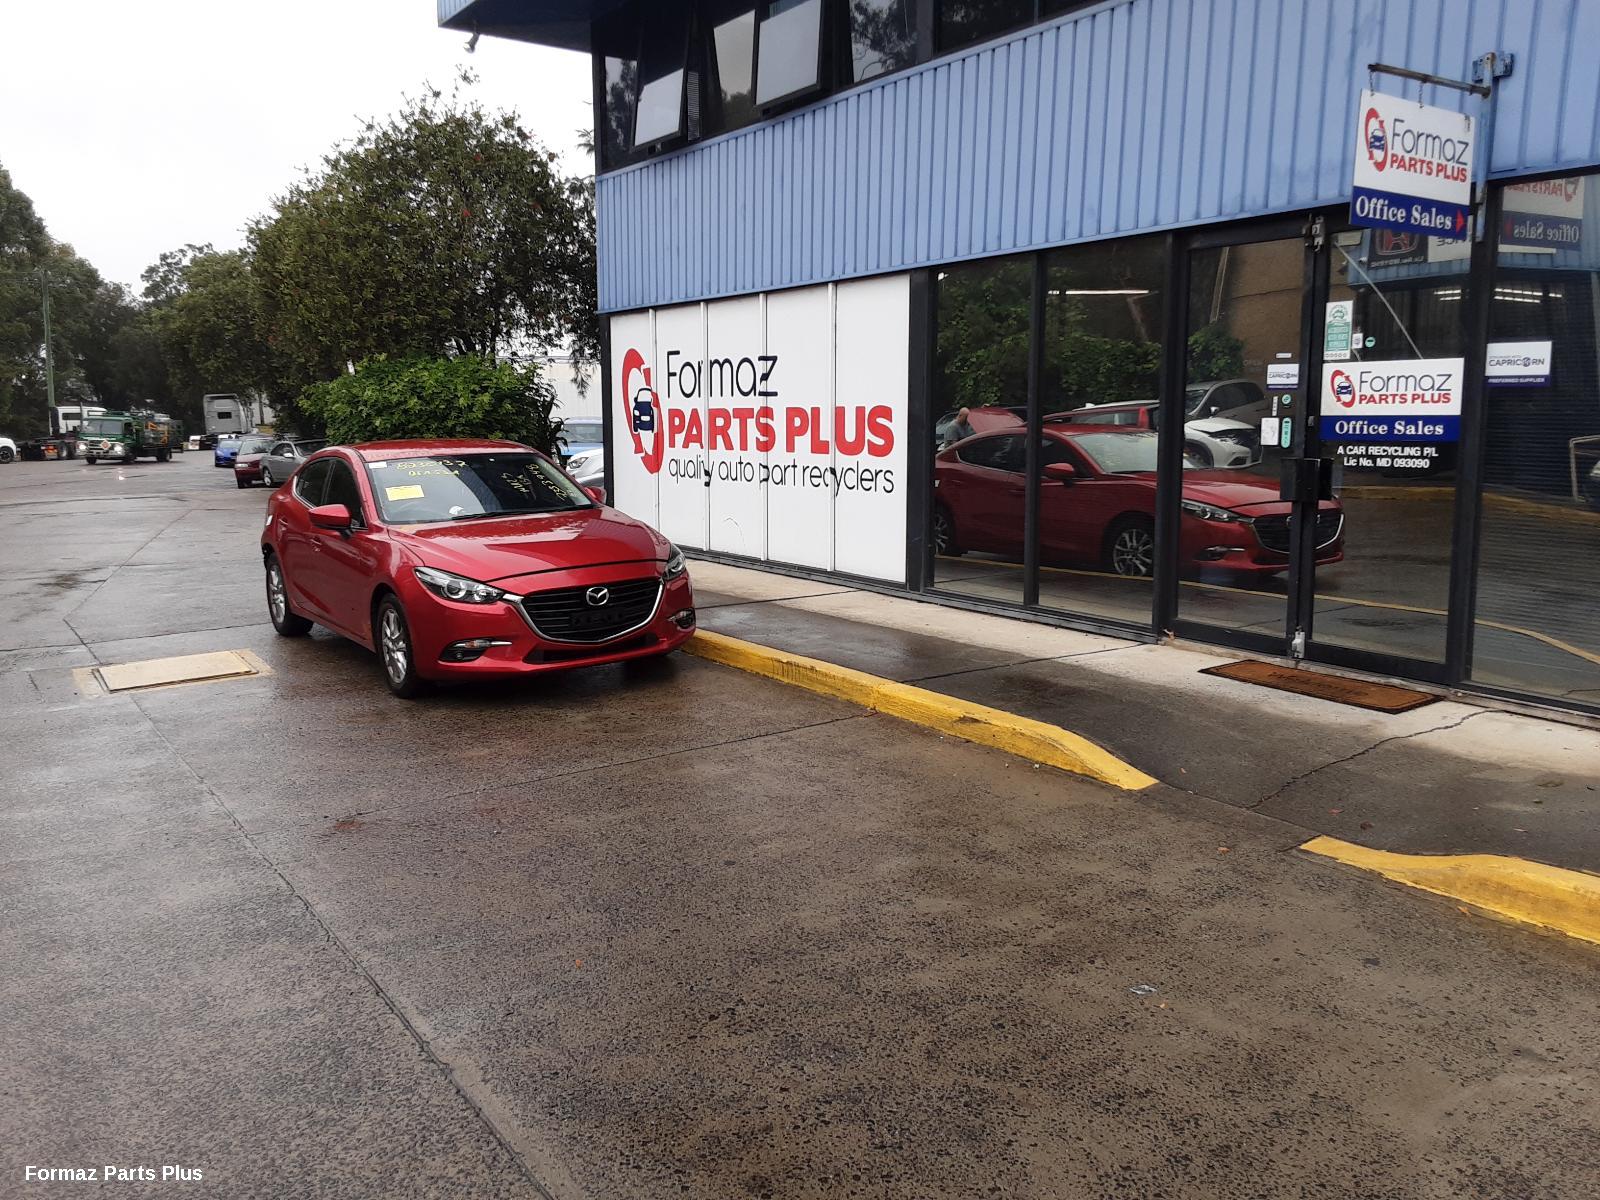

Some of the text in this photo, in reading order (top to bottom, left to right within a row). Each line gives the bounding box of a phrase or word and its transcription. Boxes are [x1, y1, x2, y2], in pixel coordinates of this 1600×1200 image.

[1391, 118, 1469, 166] Formaz
[1390, 153, 1467, 183] PARTS PLUS
[1356, 195, 1452, 230] Office Sales
[667, 350, 778, 399] Formaz
[1359, 370, 1453, 393] Formaz
[1359, 393, 1452, 405] PARTS PLUS
[668, 405, 895, 458] PARTS PLUS
[1335, 420, 1444, 435] Office Sales
[1337, 445, 1439, 458] A CAR RECYCLING P/L
[1343, 456, 1430, 469] Lic No. MD 093090
[669, 454, 895, 497] qualiy auto part recyclers
